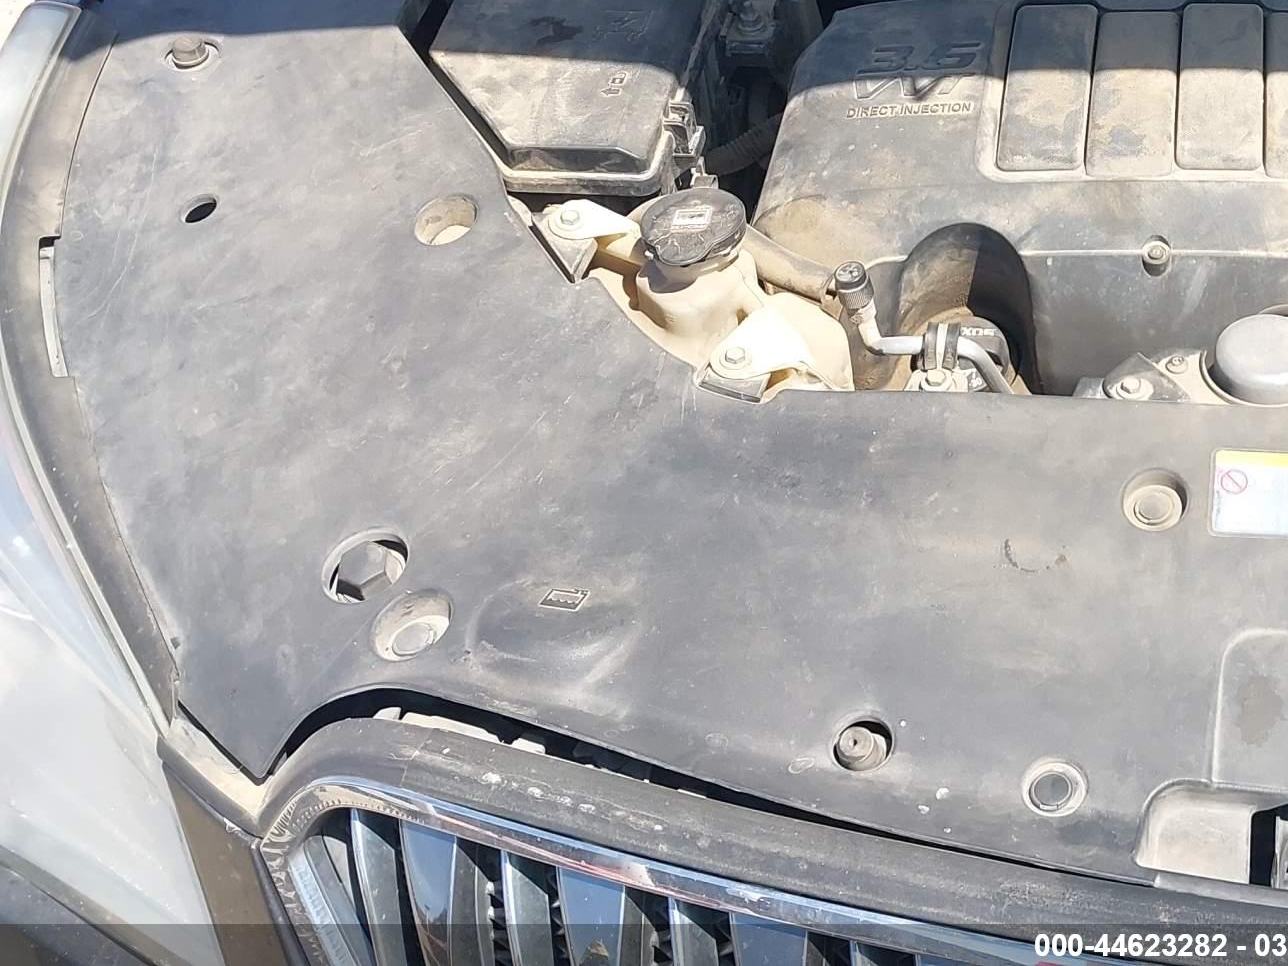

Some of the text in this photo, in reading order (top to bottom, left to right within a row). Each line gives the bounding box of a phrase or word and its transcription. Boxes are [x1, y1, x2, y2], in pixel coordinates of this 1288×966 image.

[857, 40, 981, 75] 3.6
[846, 102, 971, 119] DIRECT INJECTION
